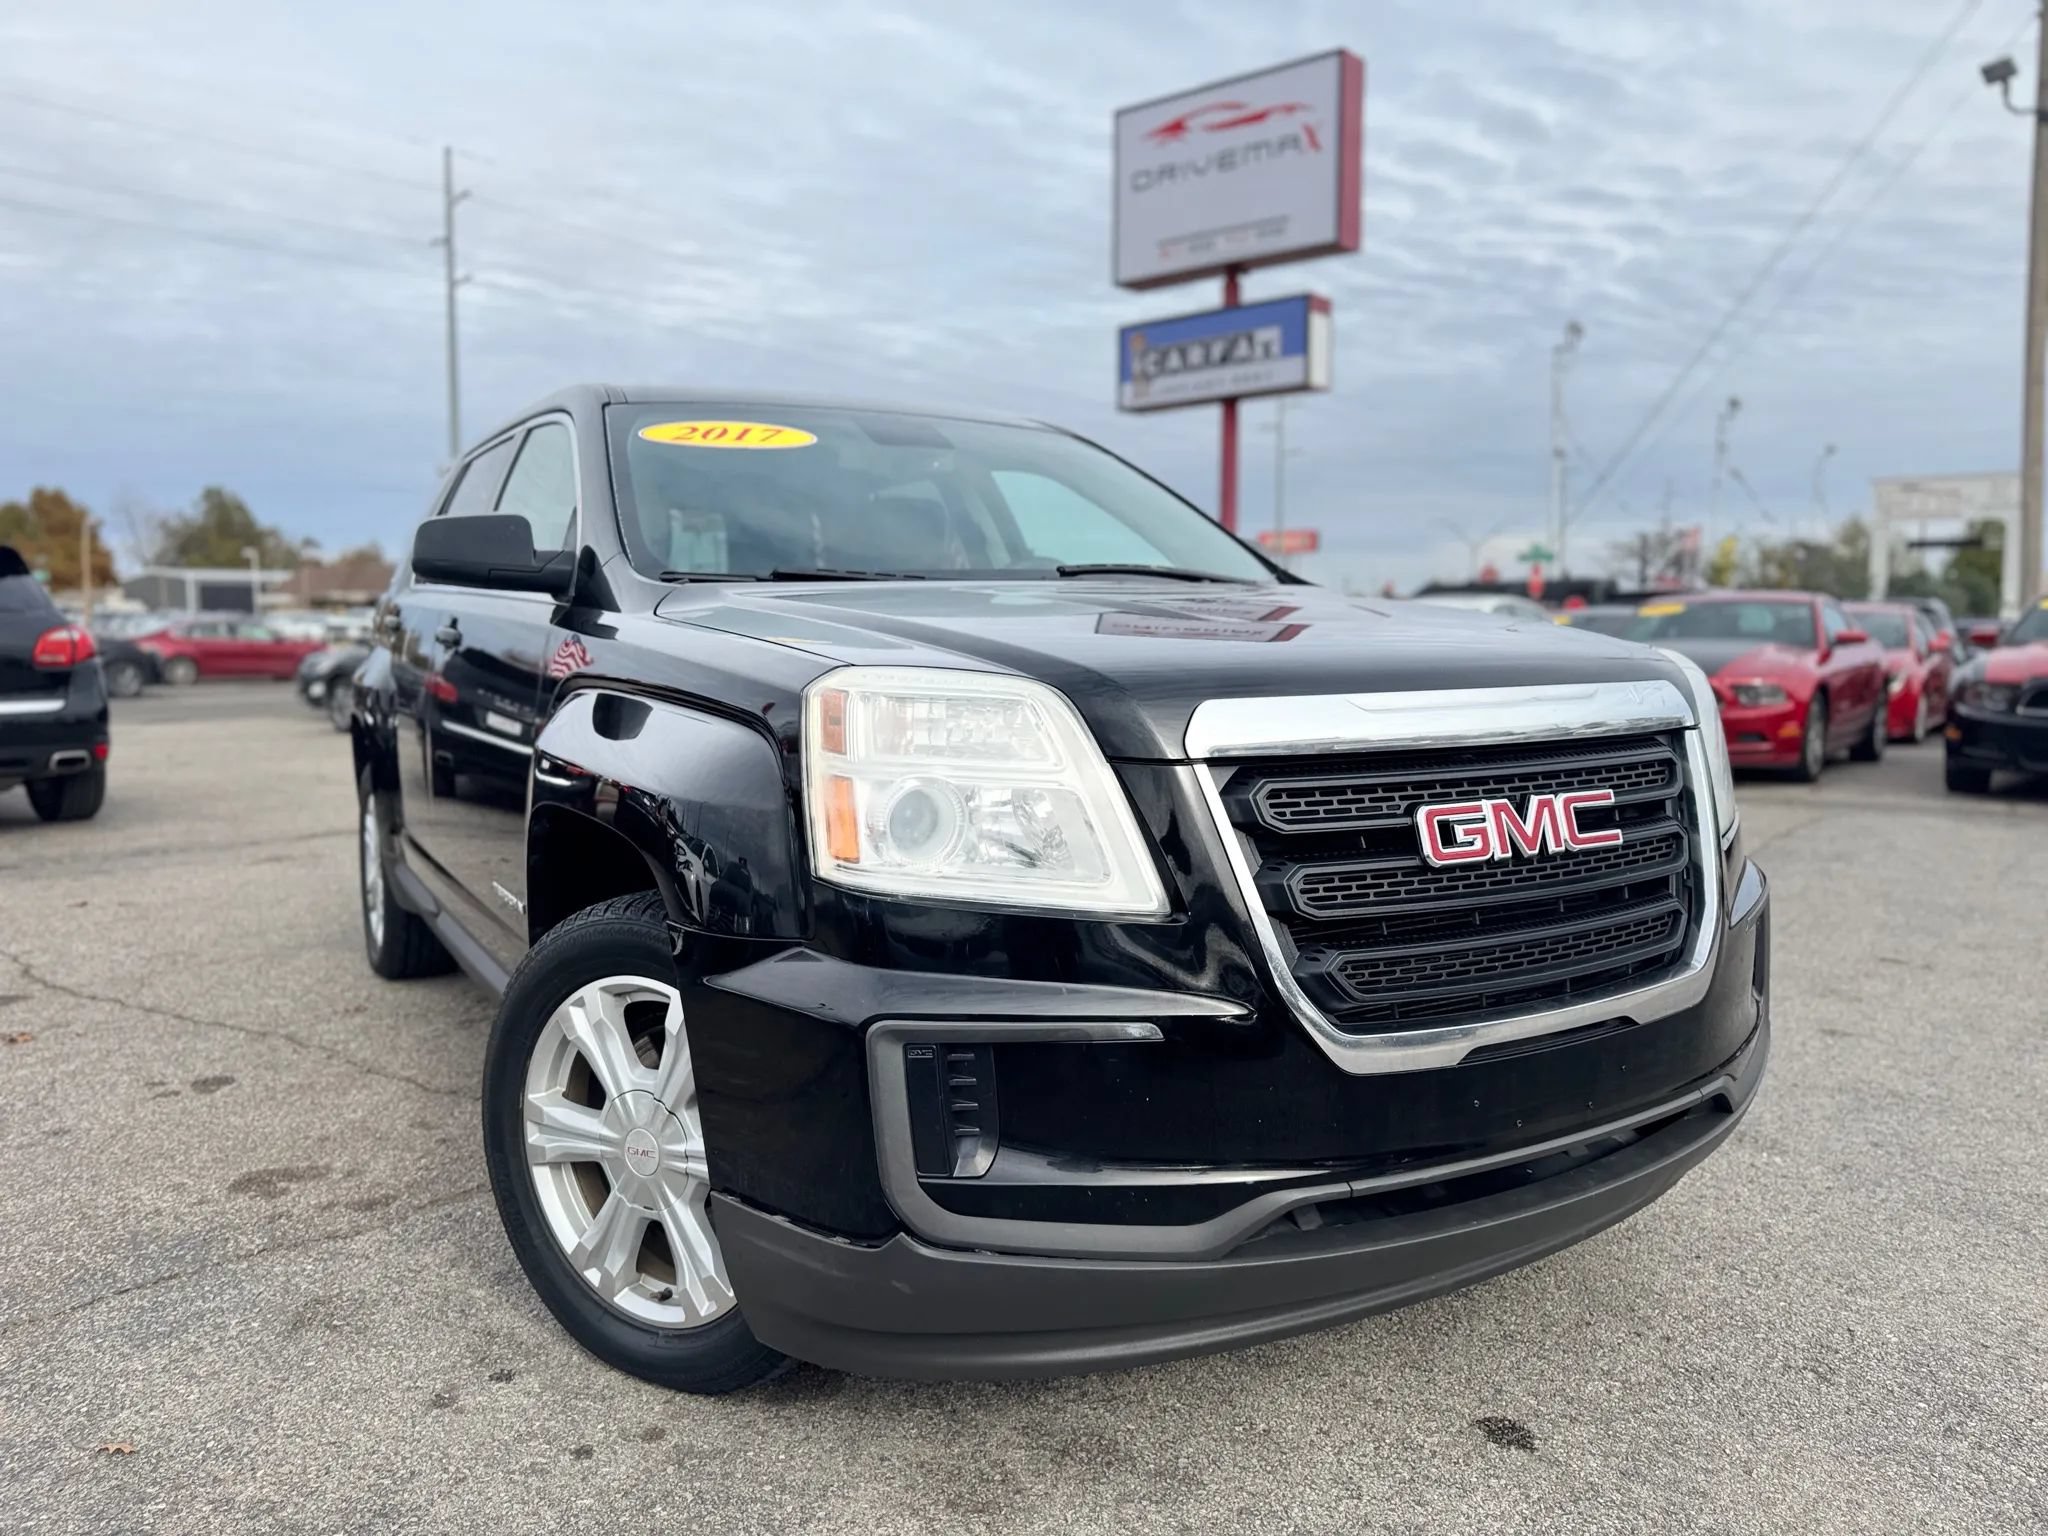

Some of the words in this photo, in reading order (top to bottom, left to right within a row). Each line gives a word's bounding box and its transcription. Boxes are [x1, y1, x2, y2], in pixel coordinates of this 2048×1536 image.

[671, 426, 785, 443] 2017
[1416, 788, 1624, 868] GMC
[627, 1146, 656, 1159] GMC
